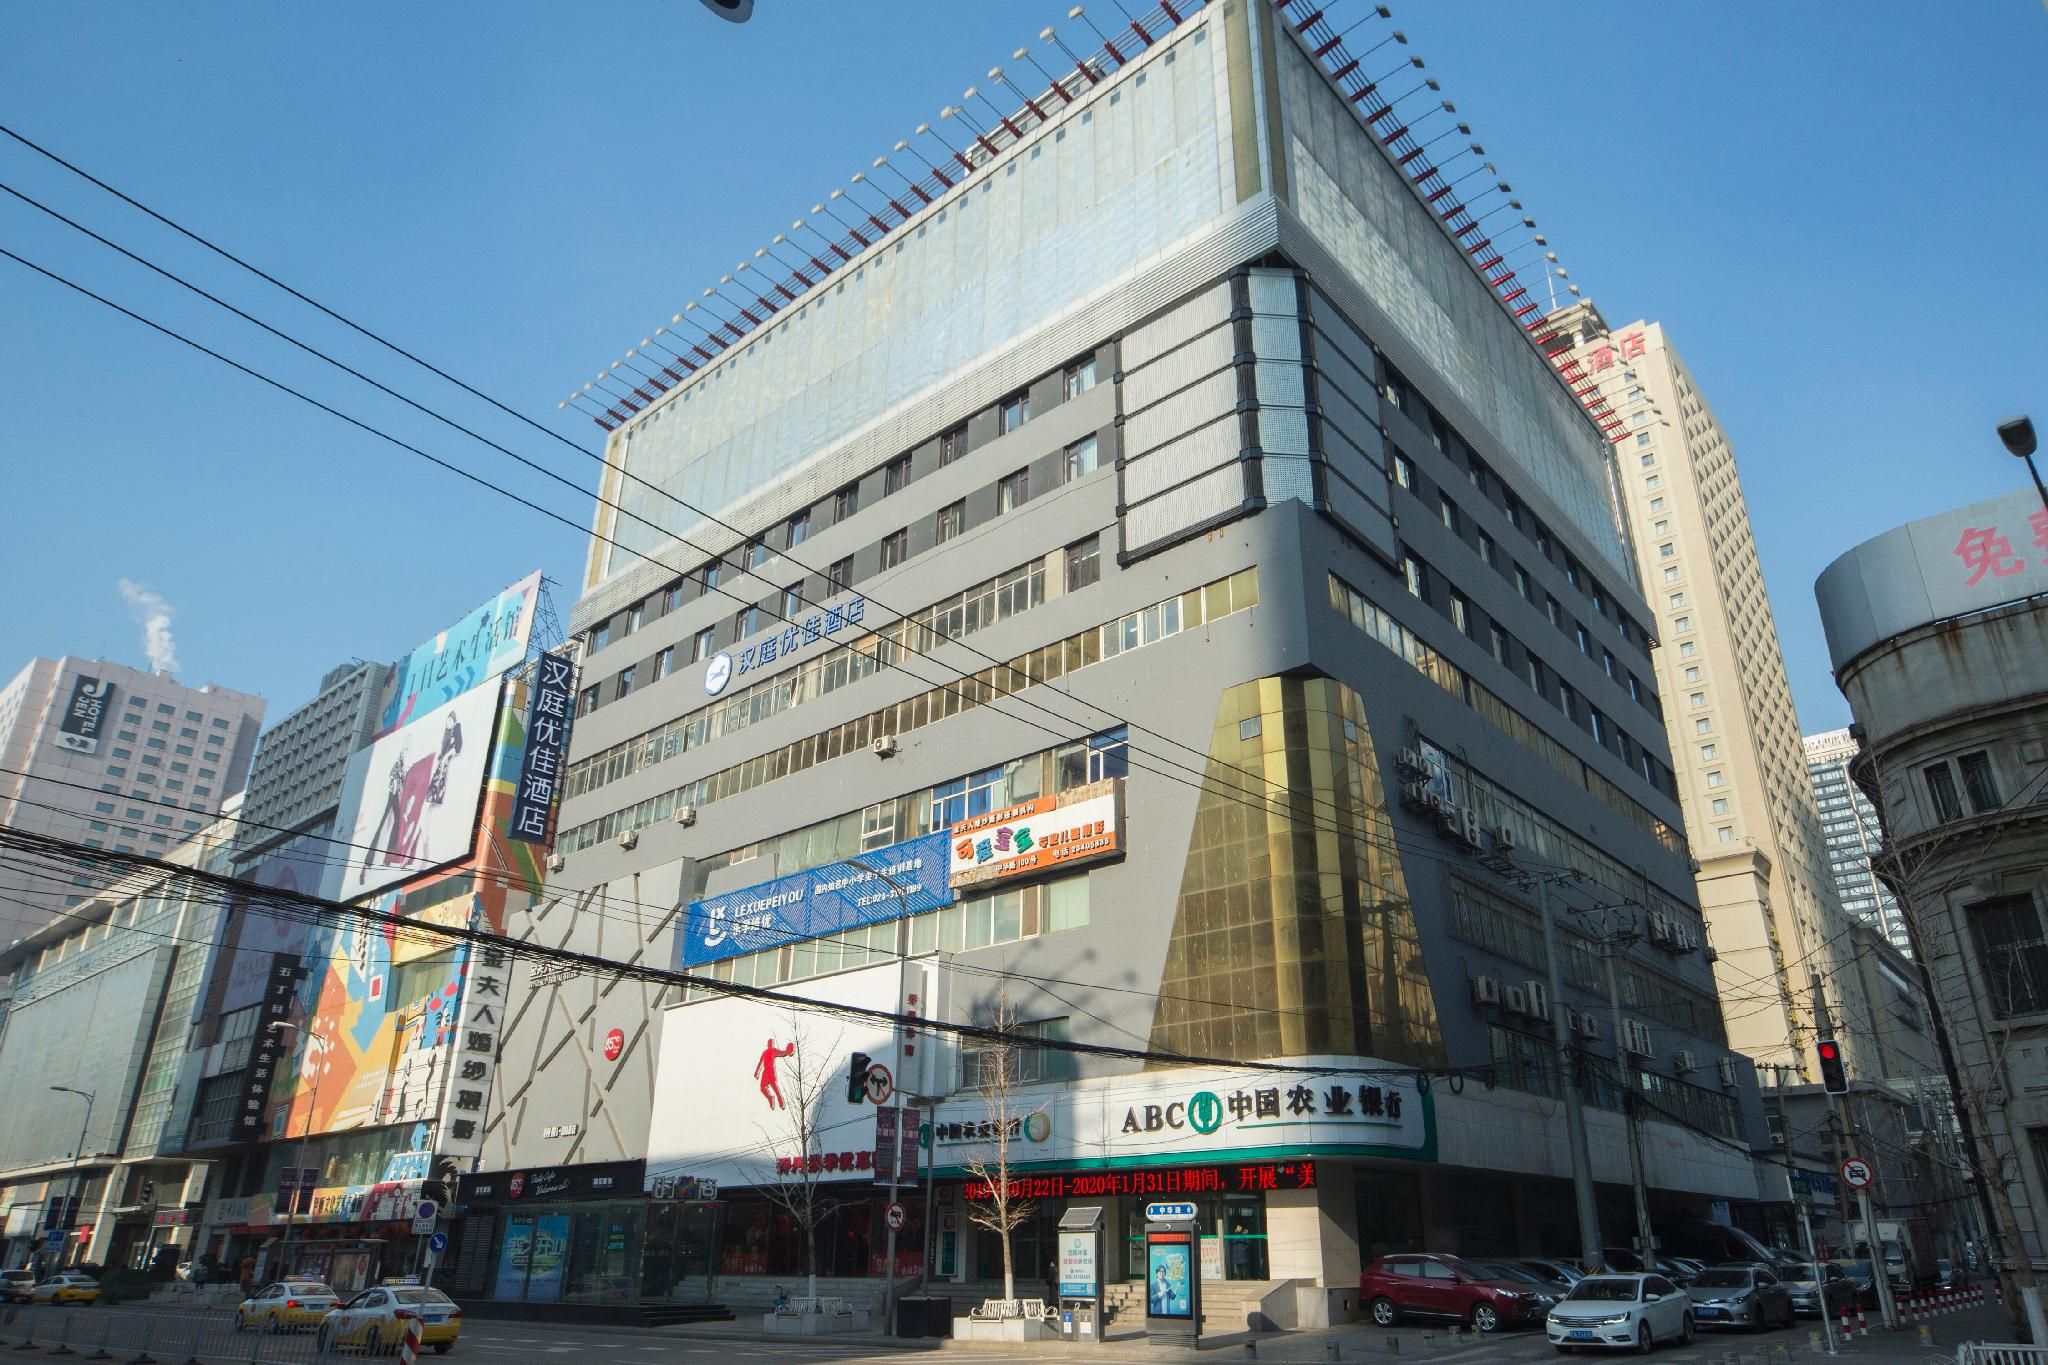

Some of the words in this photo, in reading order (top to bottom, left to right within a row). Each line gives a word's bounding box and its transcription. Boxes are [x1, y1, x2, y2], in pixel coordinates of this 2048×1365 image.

[738, 595, 865, 676] 汉庭优佳酒店
[72, 696, 90, 718] JEN
[81, 698, 103, 734] HOTEL
[517, 659, 570, 836] 汉庭优佳酒店
[243, 967, 293, 1126] 五丁目艺术生活体验馆
[1121, 1101, 1185, 1133] ABC
[1228, 1085, 1402, 1121] 中国农业银行
[1160, 1206, 1181, 1215] 中华路
